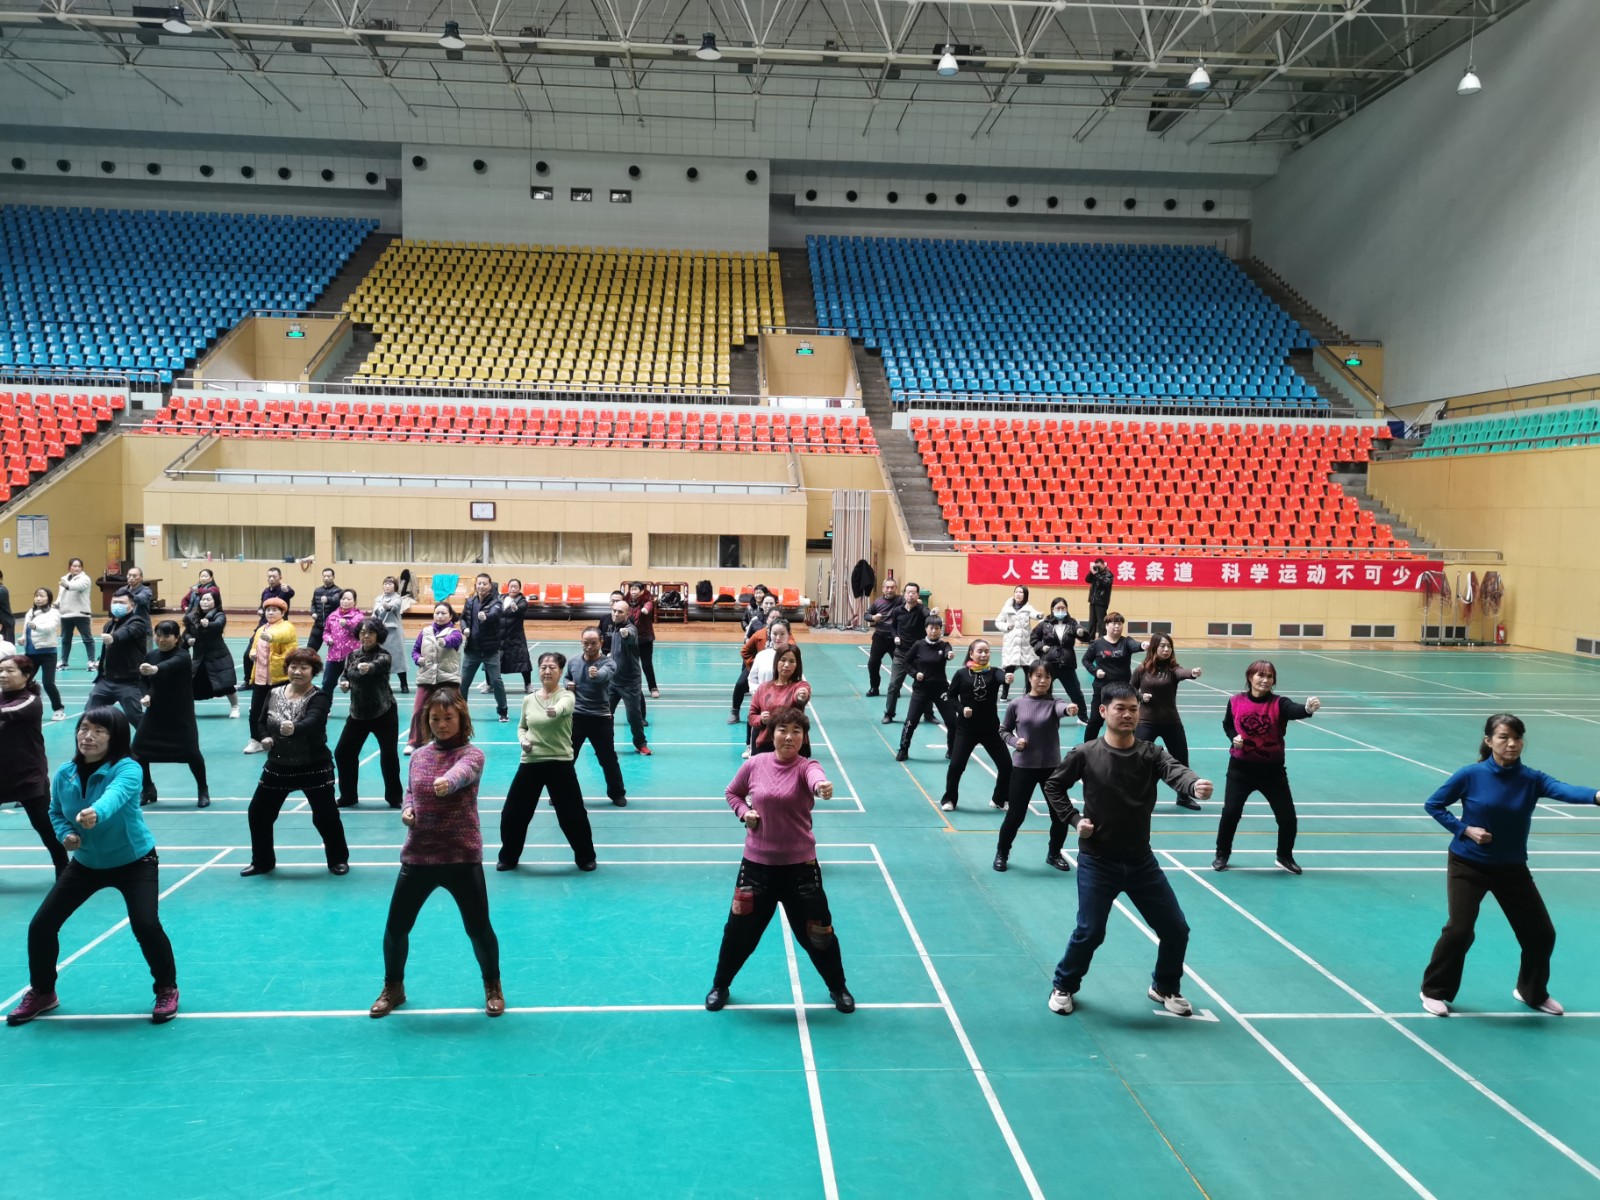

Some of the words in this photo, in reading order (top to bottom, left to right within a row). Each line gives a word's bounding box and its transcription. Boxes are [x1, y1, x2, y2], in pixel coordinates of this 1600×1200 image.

[1002, 558, 1193, 583] 人生健条条道
[1221, 562, 1411, 586] 科学运动不可少
